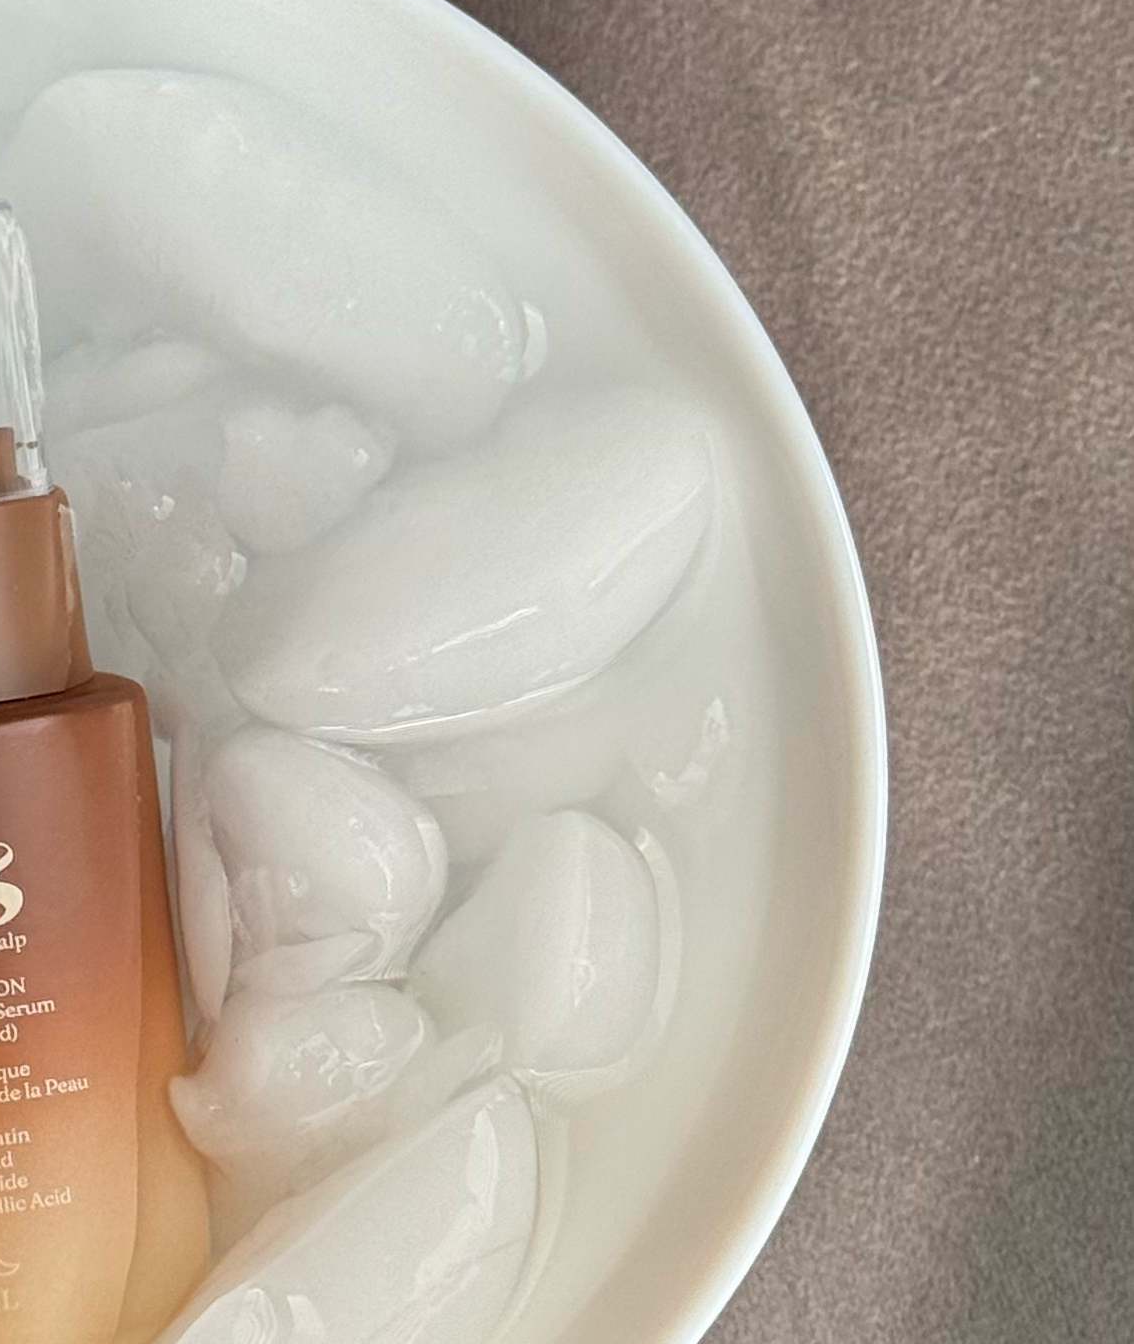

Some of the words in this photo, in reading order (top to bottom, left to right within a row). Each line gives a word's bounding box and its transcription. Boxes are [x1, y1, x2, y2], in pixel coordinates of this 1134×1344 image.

[25, 1082, 42, 1099] la
[45, 1076, 89, 1096] Peau
[30, 1186, 72, 1210] Acid
